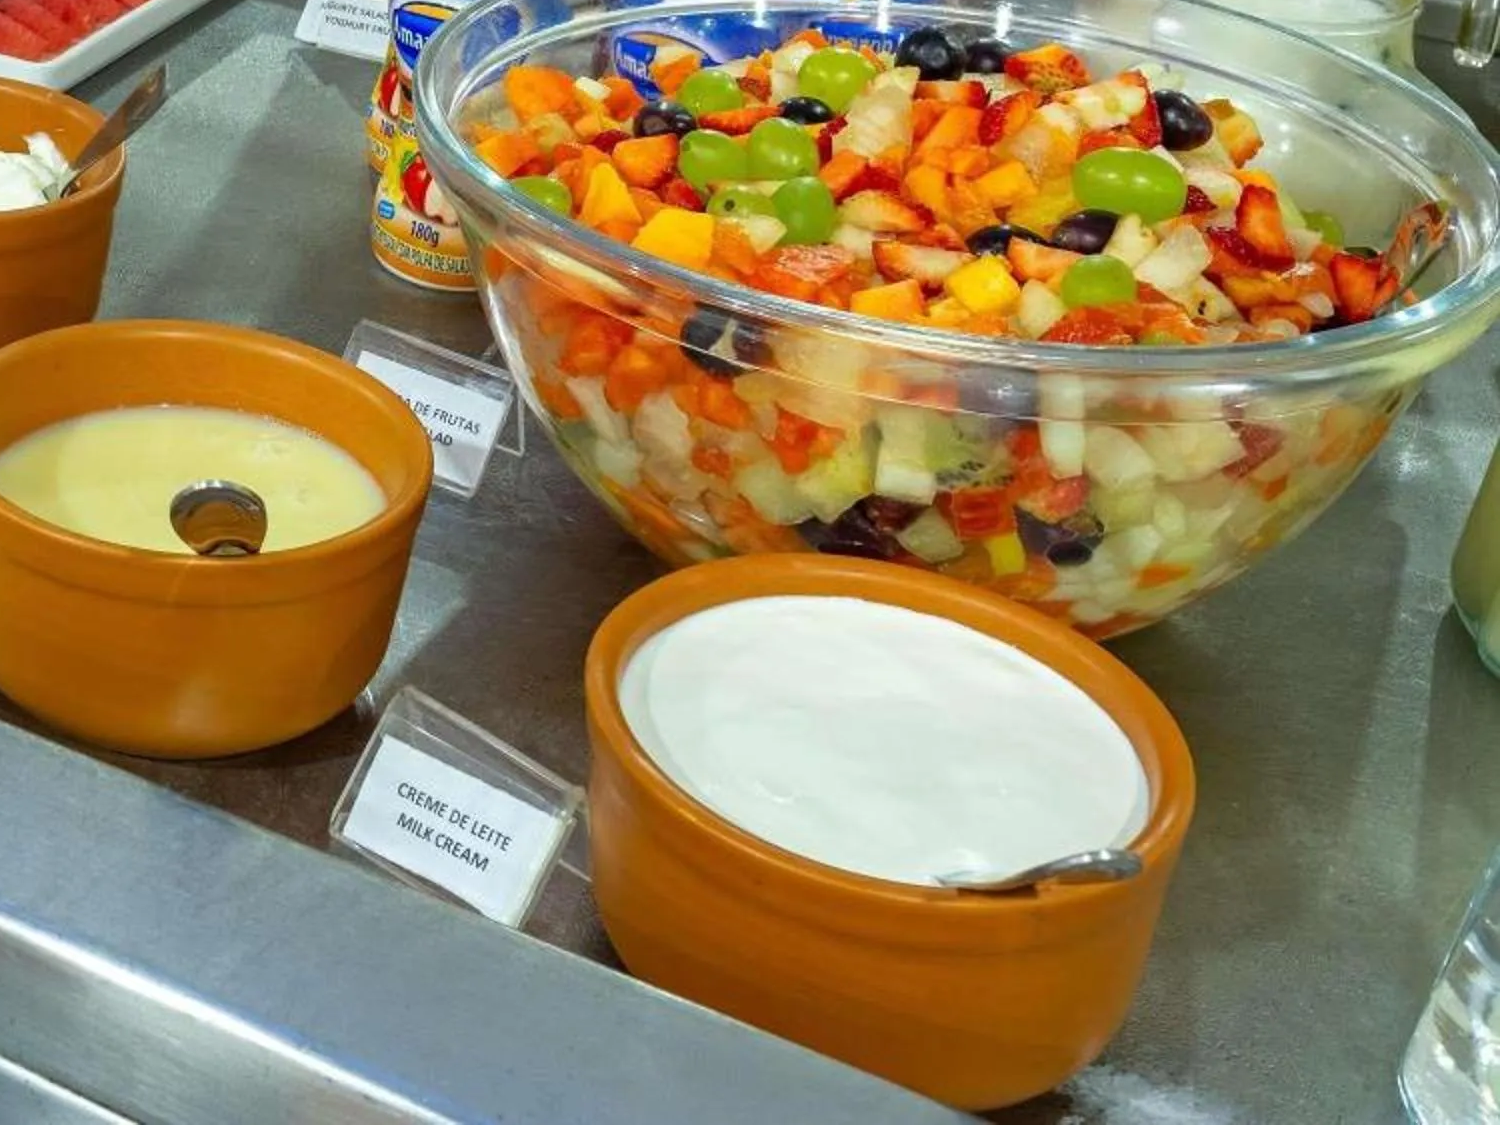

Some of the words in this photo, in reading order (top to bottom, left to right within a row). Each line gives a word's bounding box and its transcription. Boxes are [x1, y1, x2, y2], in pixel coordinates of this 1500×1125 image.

[411, 220, 440, 248] 180g
[414, 401, 431, 416] DE
[433, 408, 480, 434] FRUTAS
[397, 782, 449, 819] CREME
[449, 809, 471, 831] DE
[470, 820, 513, 852] LEITE
[396, 812, 433, 842] MILK
[434, 833, 490, 872] CREAM
